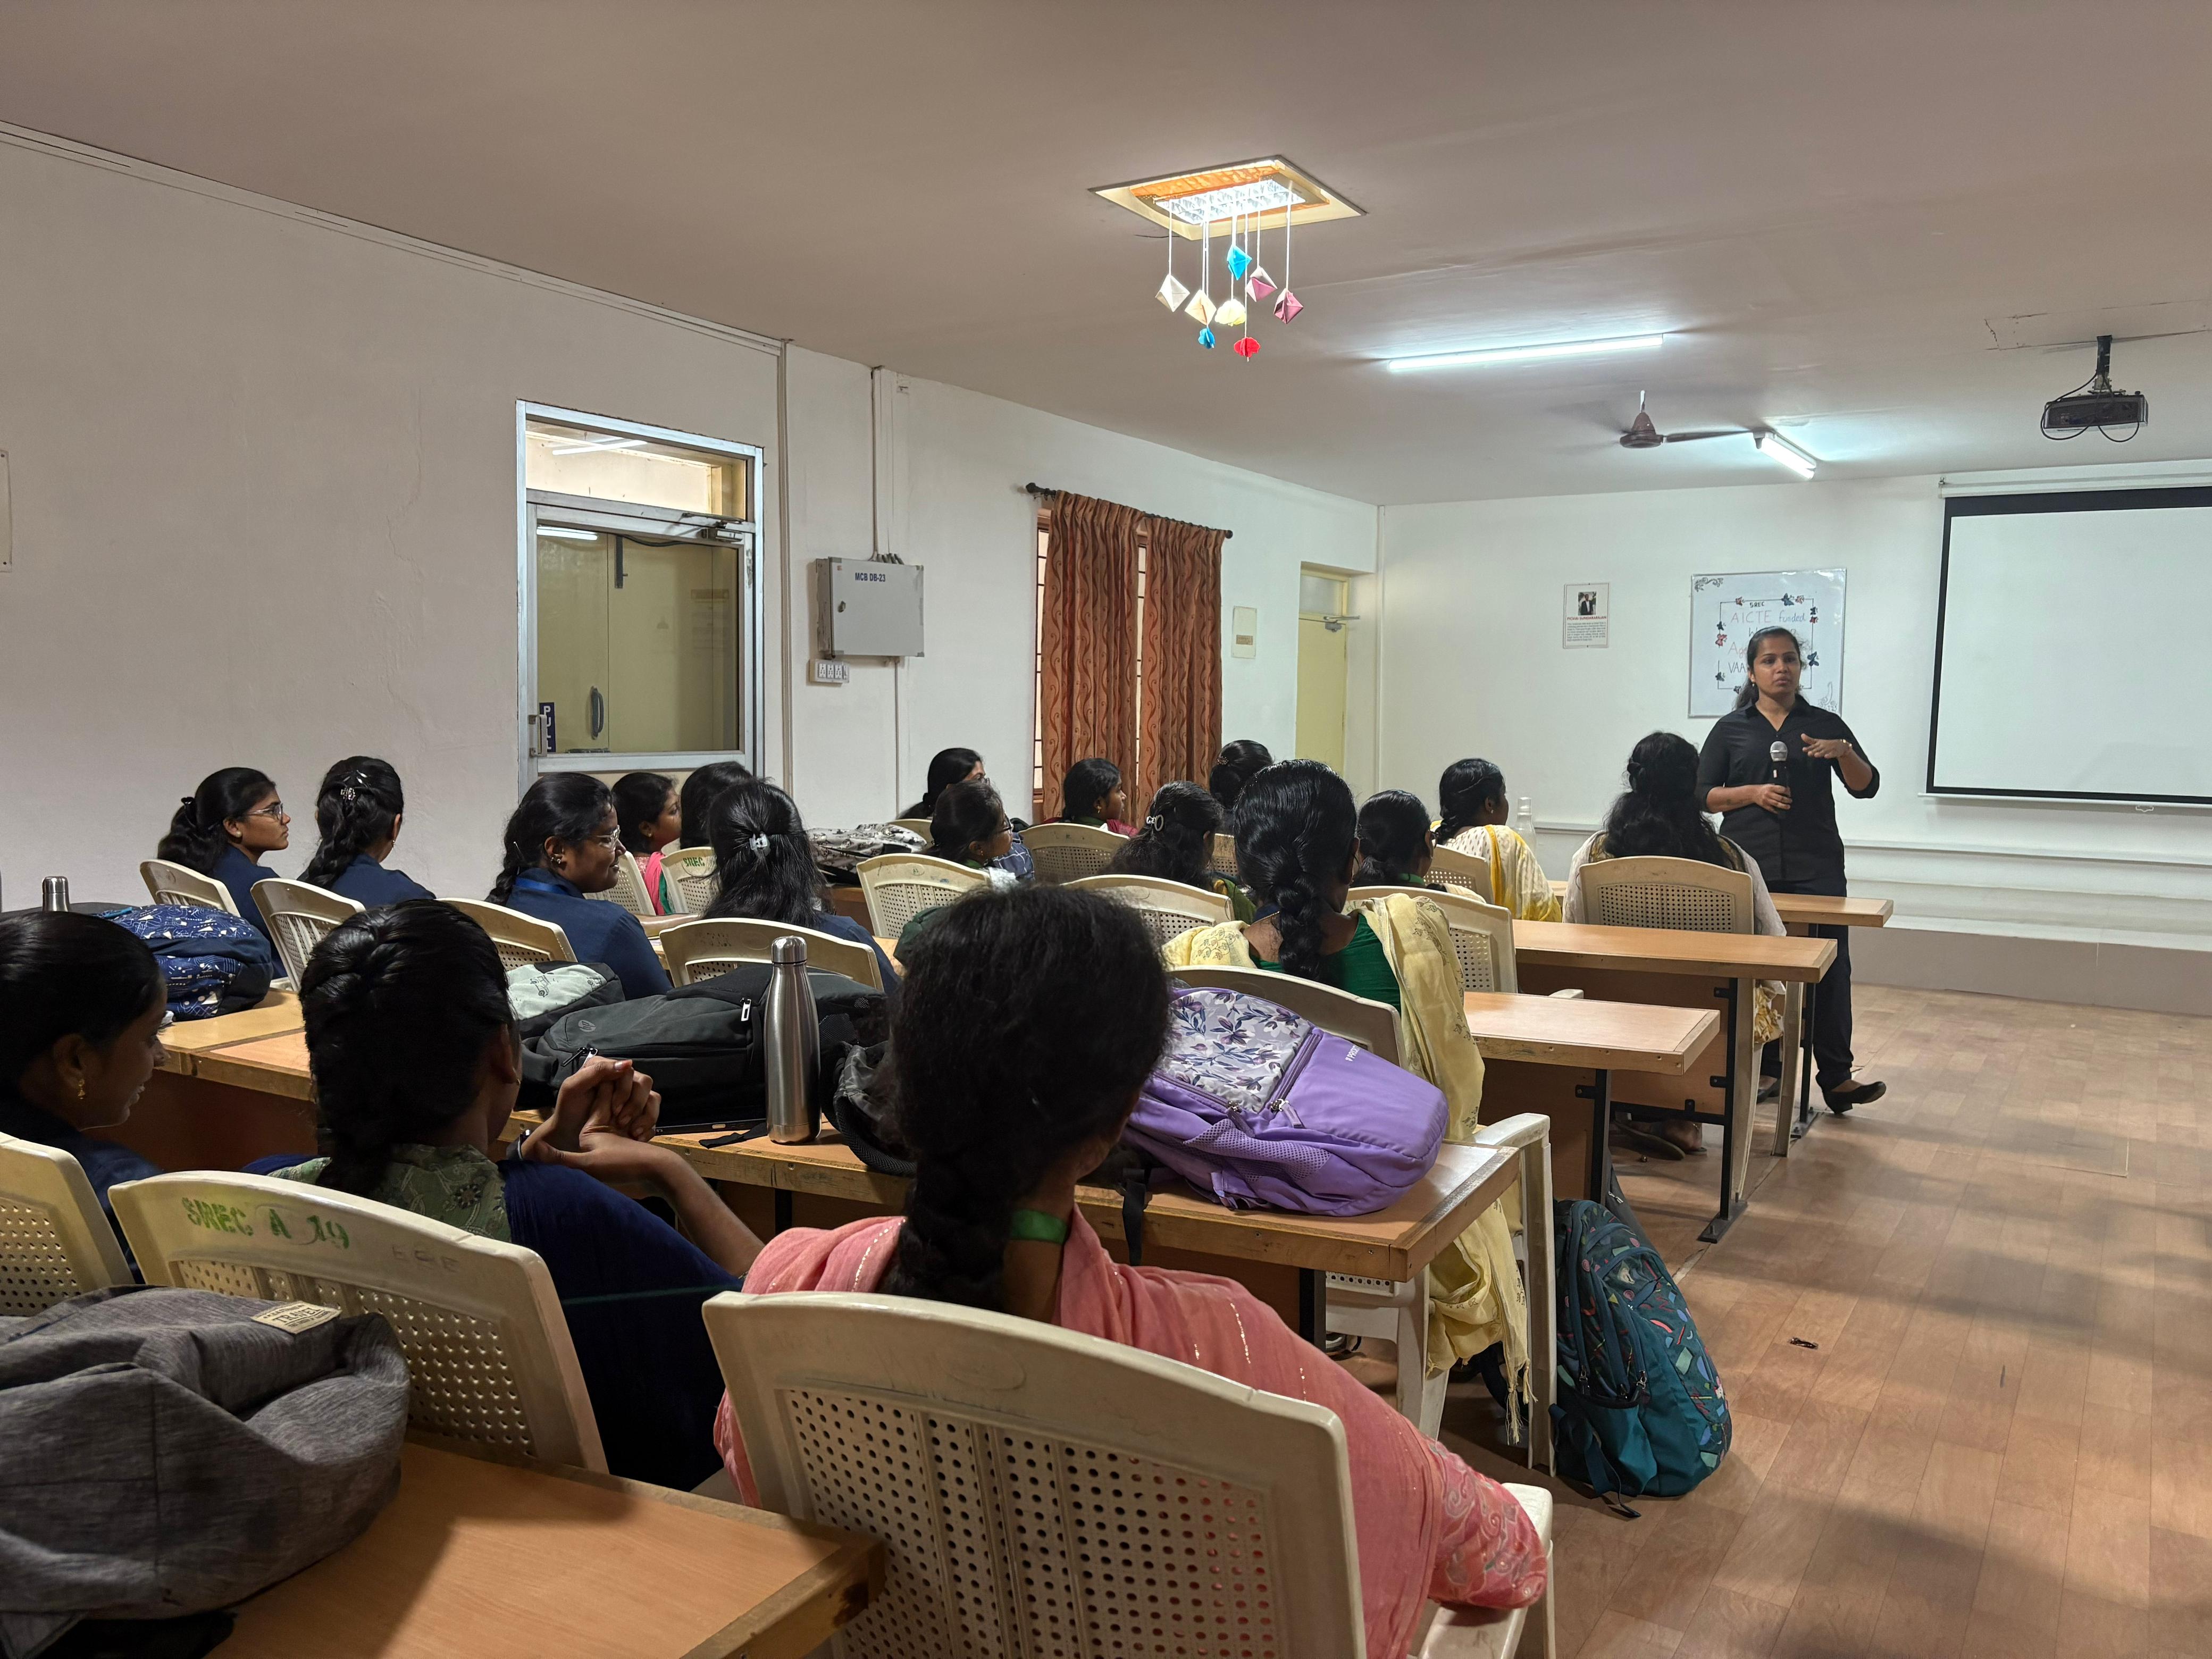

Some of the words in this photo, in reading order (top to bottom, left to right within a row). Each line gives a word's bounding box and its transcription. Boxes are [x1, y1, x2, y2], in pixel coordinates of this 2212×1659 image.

[855, 572, 868, 581] MCB
[869, 573, 885, 582] DB-23
[1730, 610, 1772, 623] AICTE
[683, 857, 705, 867] SREC
[272, 1308, 321, 1323] TRAVEL
